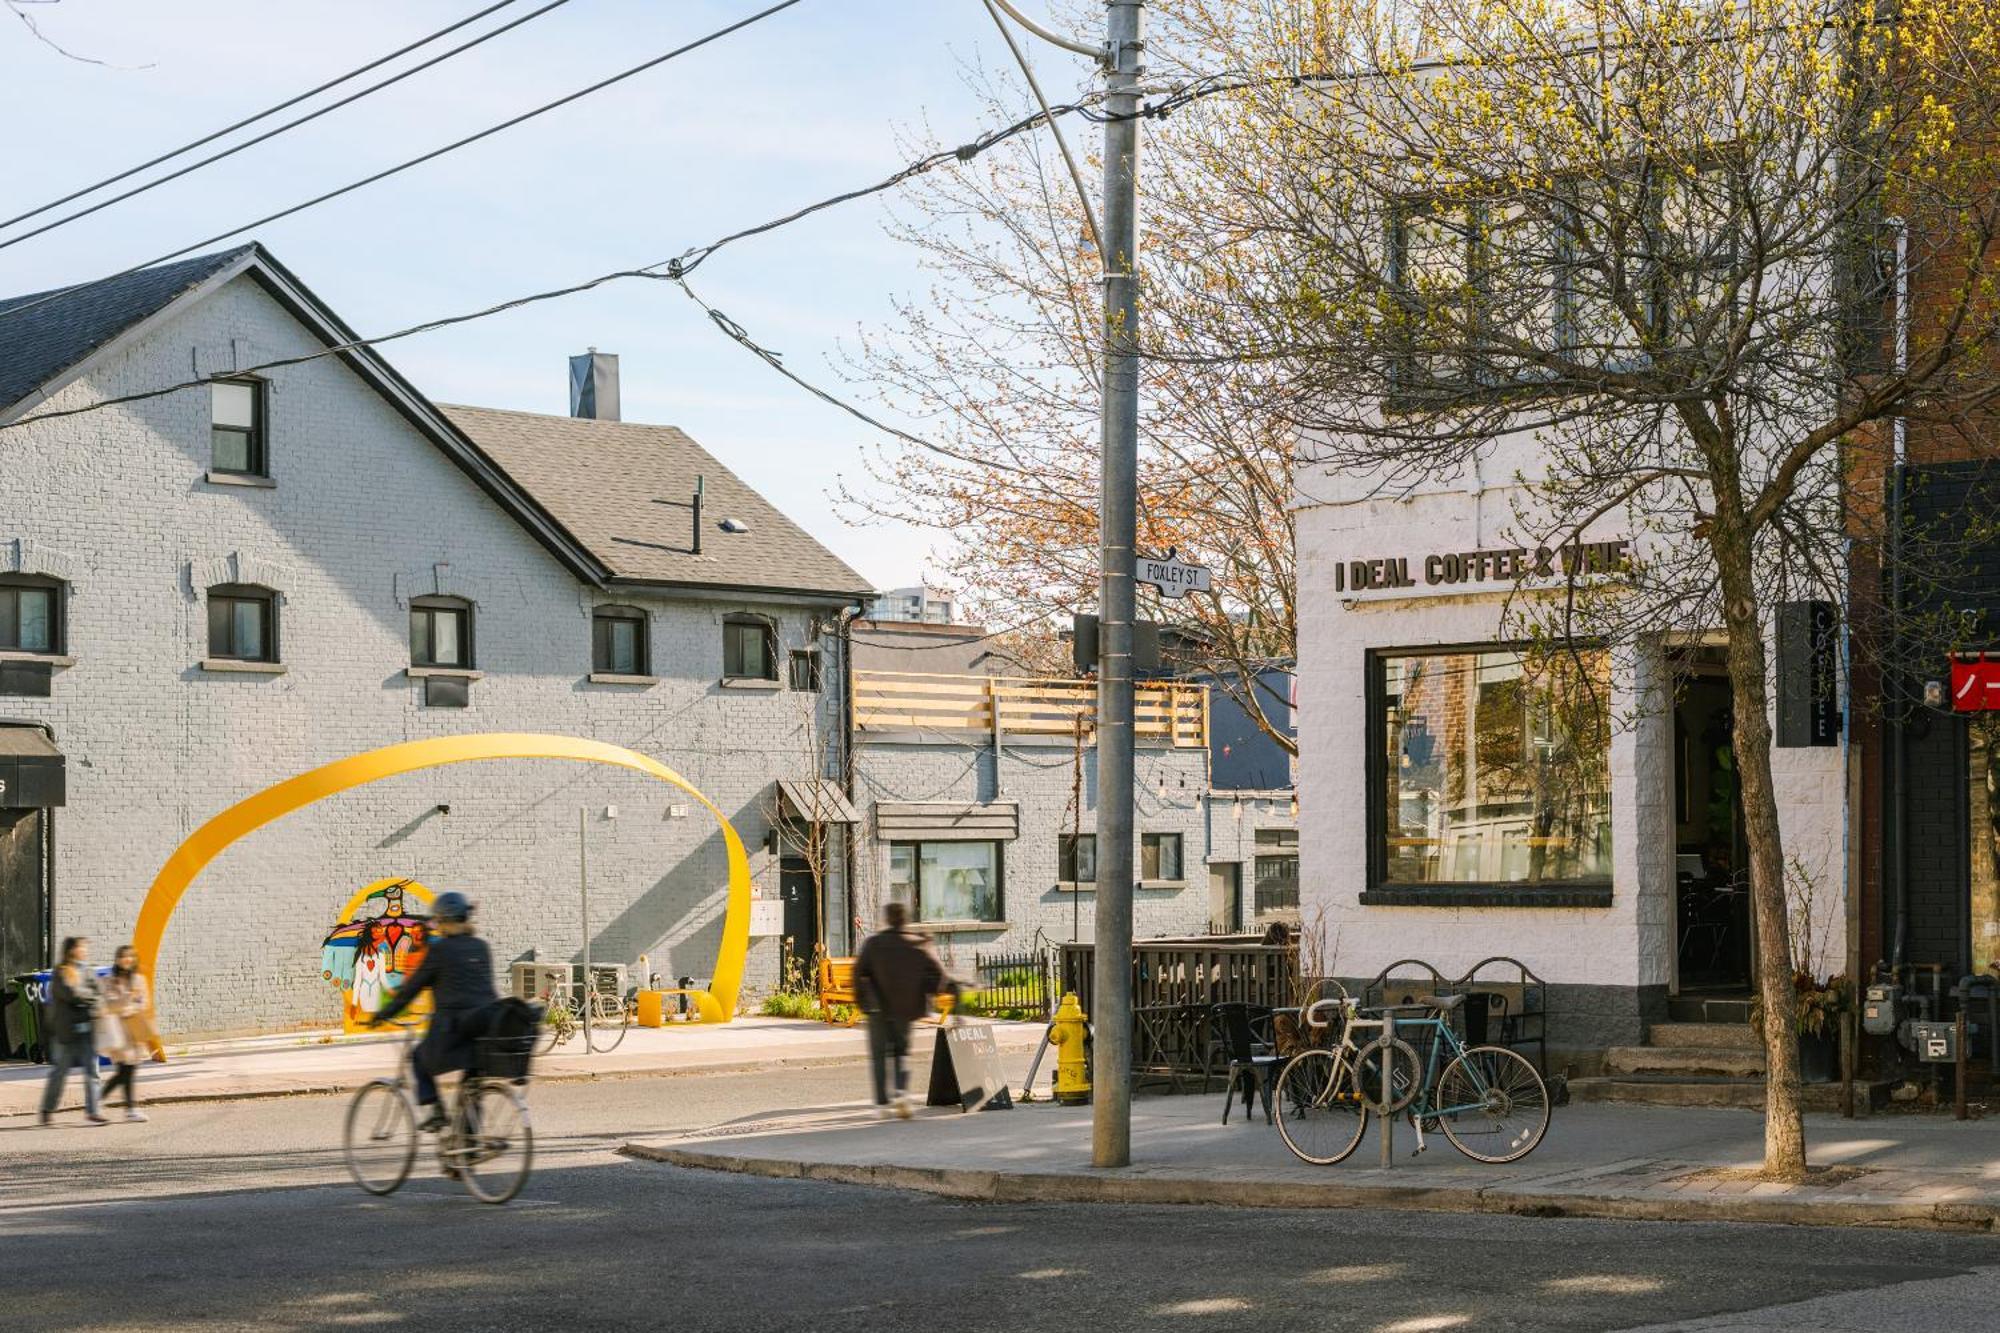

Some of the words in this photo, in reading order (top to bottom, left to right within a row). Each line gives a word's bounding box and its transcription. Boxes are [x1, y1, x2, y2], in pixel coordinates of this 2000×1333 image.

[1147, 563, 1185, 584] FOXLEY
[1336, 562, 1344, 592] I
[1350, 557, 1416, 590] DEAL
[1425, 549, 1527, 585] COFFEE
[1534, 546, 1554, 577] &
[958, 1027, 988, 1041] DEAL
